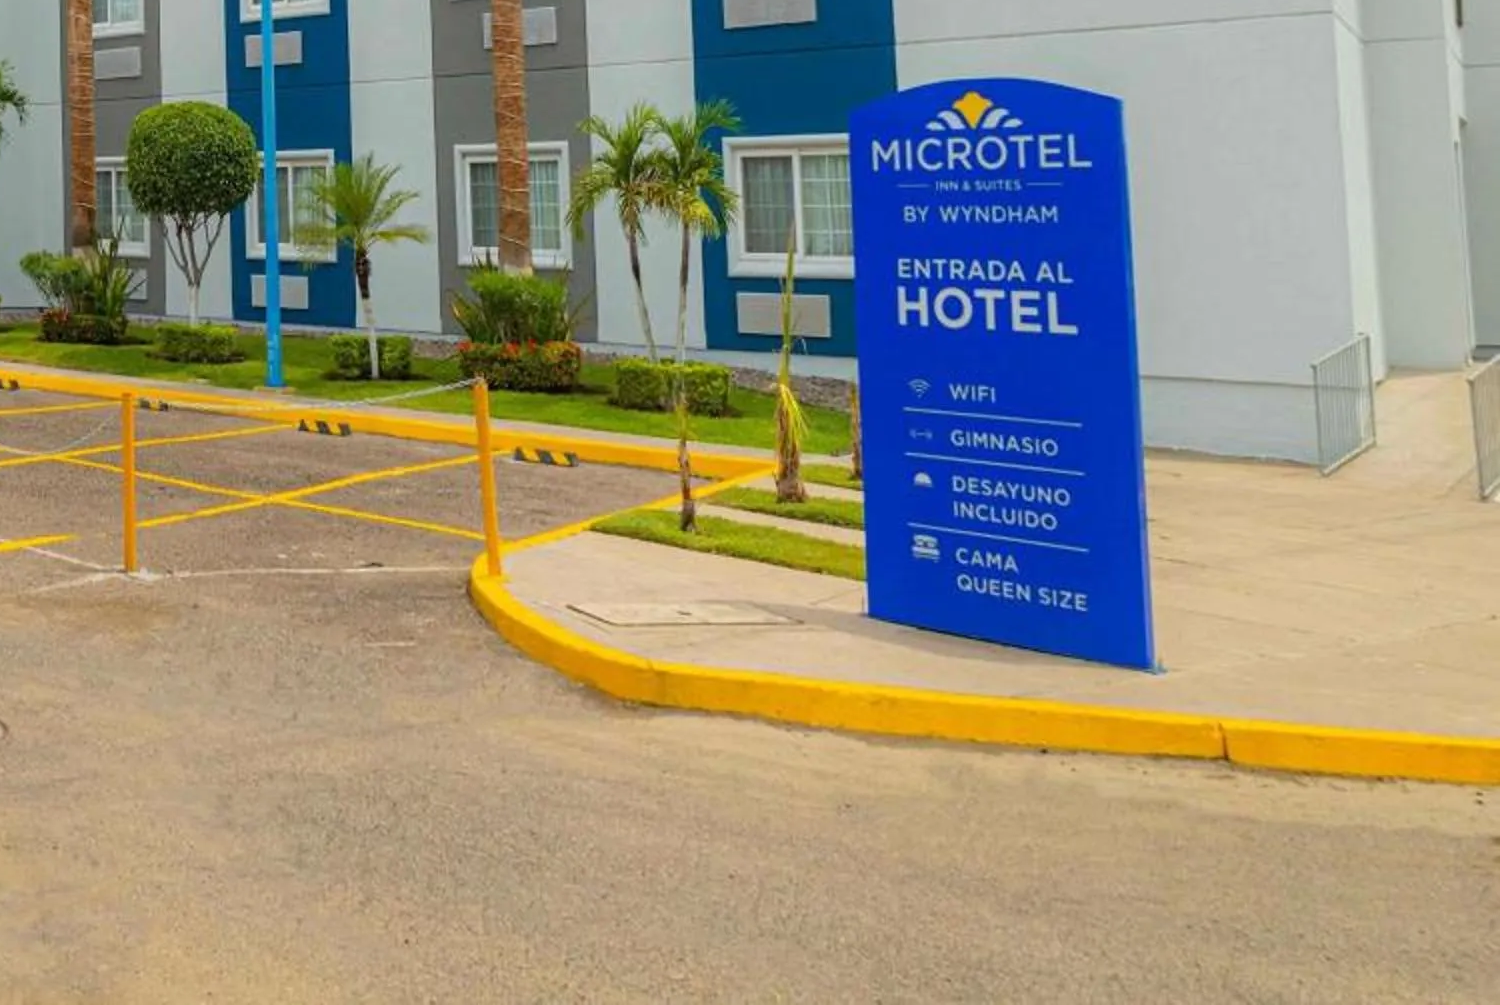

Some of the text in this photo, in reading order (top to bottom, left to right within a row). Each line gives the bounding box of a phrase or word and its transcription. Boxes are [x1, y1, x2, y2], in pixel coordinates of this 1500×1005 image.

[871, 133, 1093, 172] MICROTEL
[935, 179, 1022, 191] INN & SUITES
[903, 205, 1058, 223] BY WYNDHAM
[897, 258, 1073, 283] ENTRADA AL
[897, 286, 1078, 334] HOTEL
[949, 384, 996, 403] WIFI
[950, 429, 1058, 457] GIMNASIO
[952, 475, 1071, 506] DESAYUNO
[953, 501, 1058, 530] INCLUIDO
[955, 548, 1019, 573] CAMA
[957, 574, 1088, 611] QUEEN SIZE
